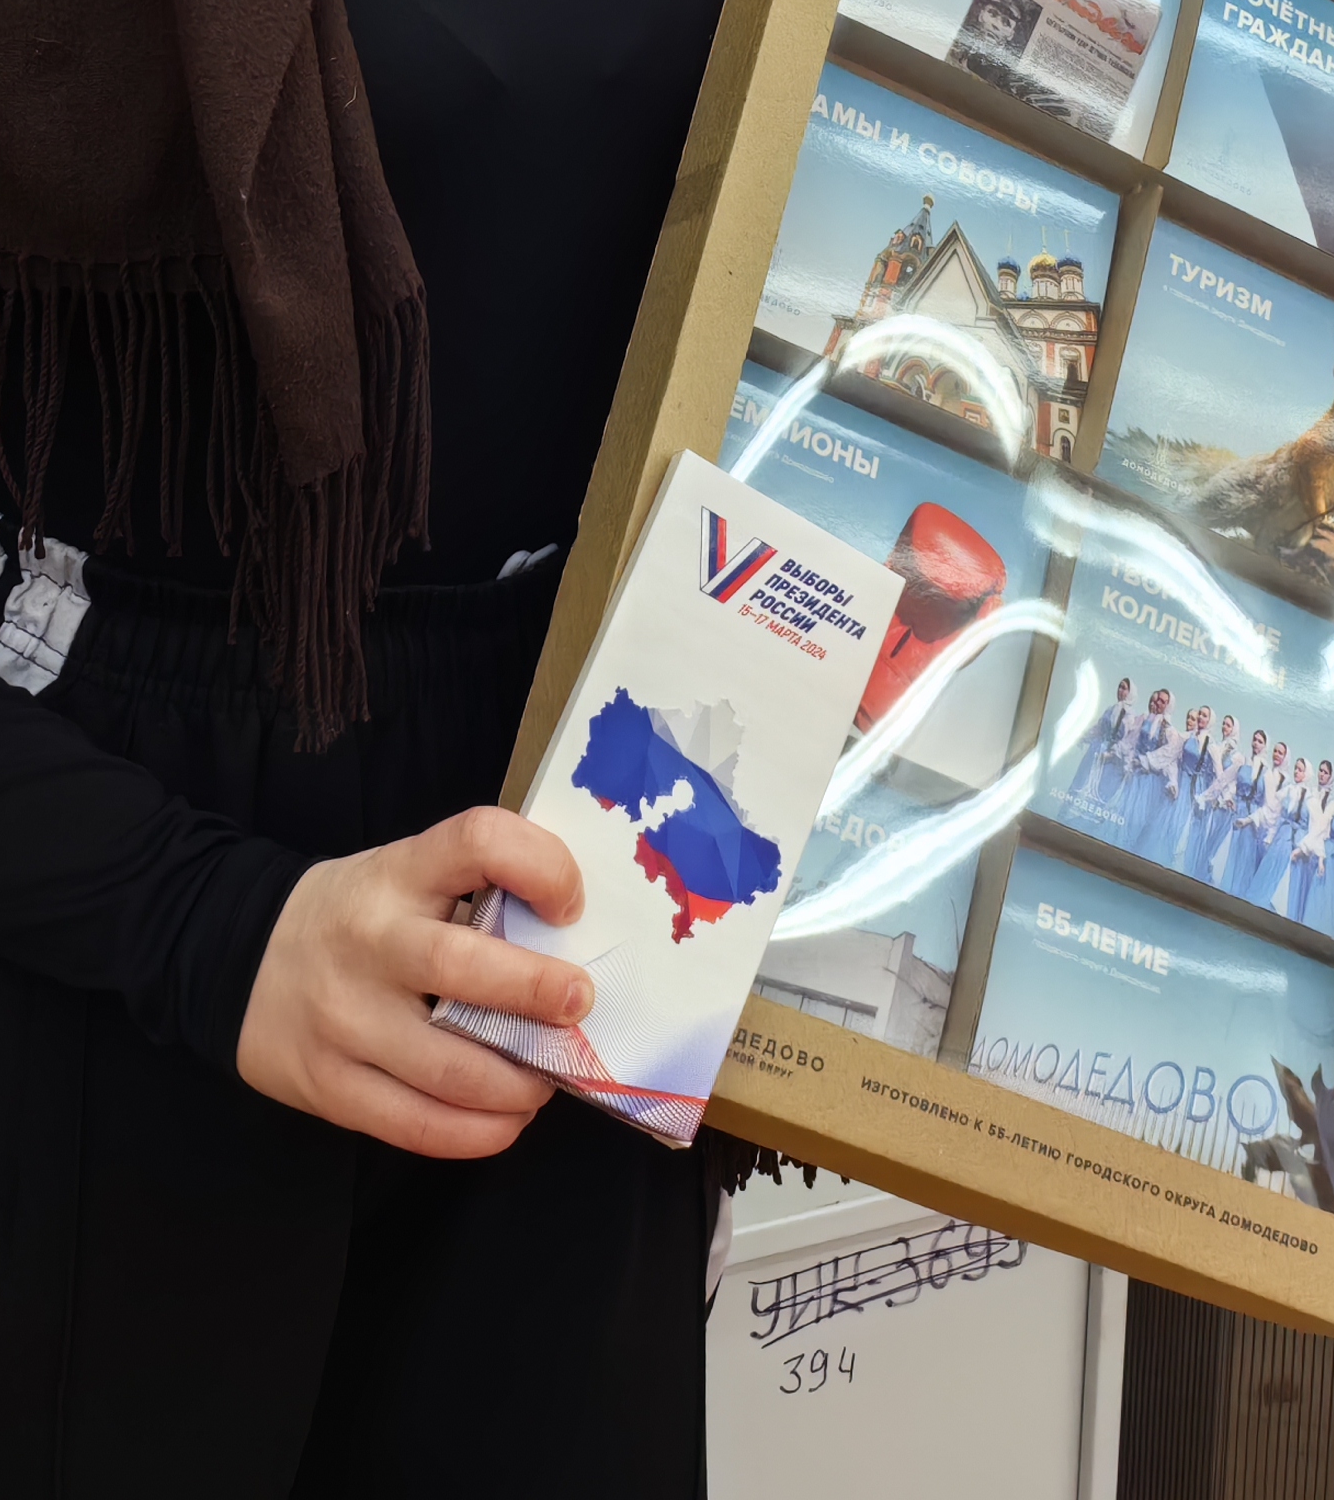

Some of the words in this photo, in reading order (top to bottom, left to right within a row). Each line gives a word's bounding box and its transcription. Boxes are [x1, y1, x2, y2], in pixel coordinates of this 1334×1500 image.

[810, 93, 882, 142] АМЫ
[889, 127, 911, 154] И
[918, 142, 1040, 216] СОБОРЫ
[1169, 253, 1273, 321] ТУРИЗМ
[730, 395, 881, 480] ЕМИОНЫ
[1121, 457, 1191, 496] ДОМОДЕДОВО
[764, 573, 868, 641] ПРЕЗИДЕНТА
[779, 558, 855, 607] ВЫБОРЫ
[749, 588, 819, 634] РОССИИ
[765, 619, 803, 648] МАРТА
[800, 639, 828, 662] 2024
[1049, 787, 1125, 826] ДОМОДЕДОВО
[1036, 902, 1171, 976] 55-ЛЕТИЕ
[732, 1027, 825, 1072] ДЕДОВО
[758, 1059, 794, 1079] ОКРУГ
[966, 1036, 1278, 1136] ДОМОДЕДОВО
[861, 1076, 969, 1127] ИЗГОТОВЛЕНО
[973, 1119, 984, 1132] К
[988, 1123, 1062, 1162] 55-ЛЕТИЮ
[1066, 1152, 1162, 1197] ГОРОДСКОГО
[1164, 1189, 1217, 1220] ОКРУГА
[1219, 1210, 1319, 1256] ДОМОДЕДОВО
[779, 1346, 856, 1394] 394
